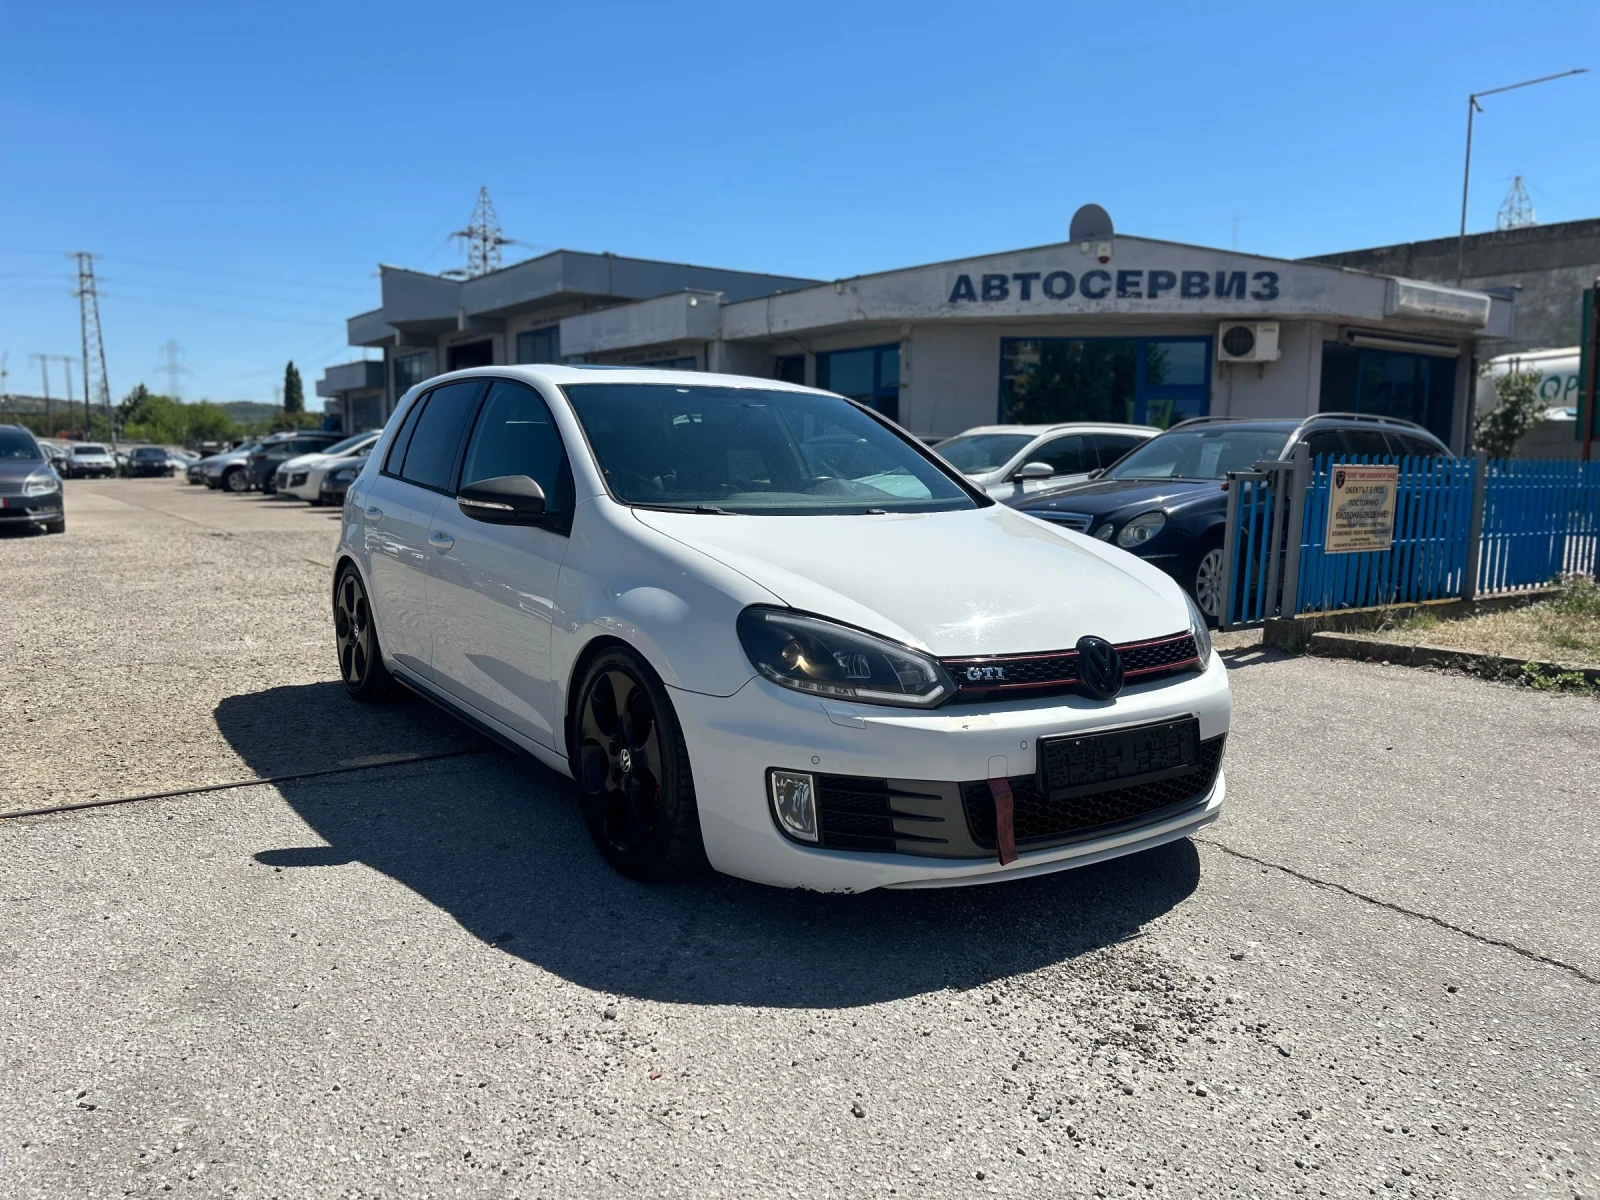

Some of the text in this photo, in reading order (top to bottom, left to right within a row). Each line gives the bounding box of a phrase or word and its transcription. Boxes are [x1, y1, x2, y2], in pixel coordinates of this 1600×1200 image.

[948, 269, 1280, 303] АВТОСЕРВИЗ
[1345, 486, 1369, 494] ОБЕКТЪТ
[1373, 486, 1385, 494] ПОД
[1348, 499, 1379, 507] ПОСТОЯННО
[966, 666, 1005, 681] GTI
